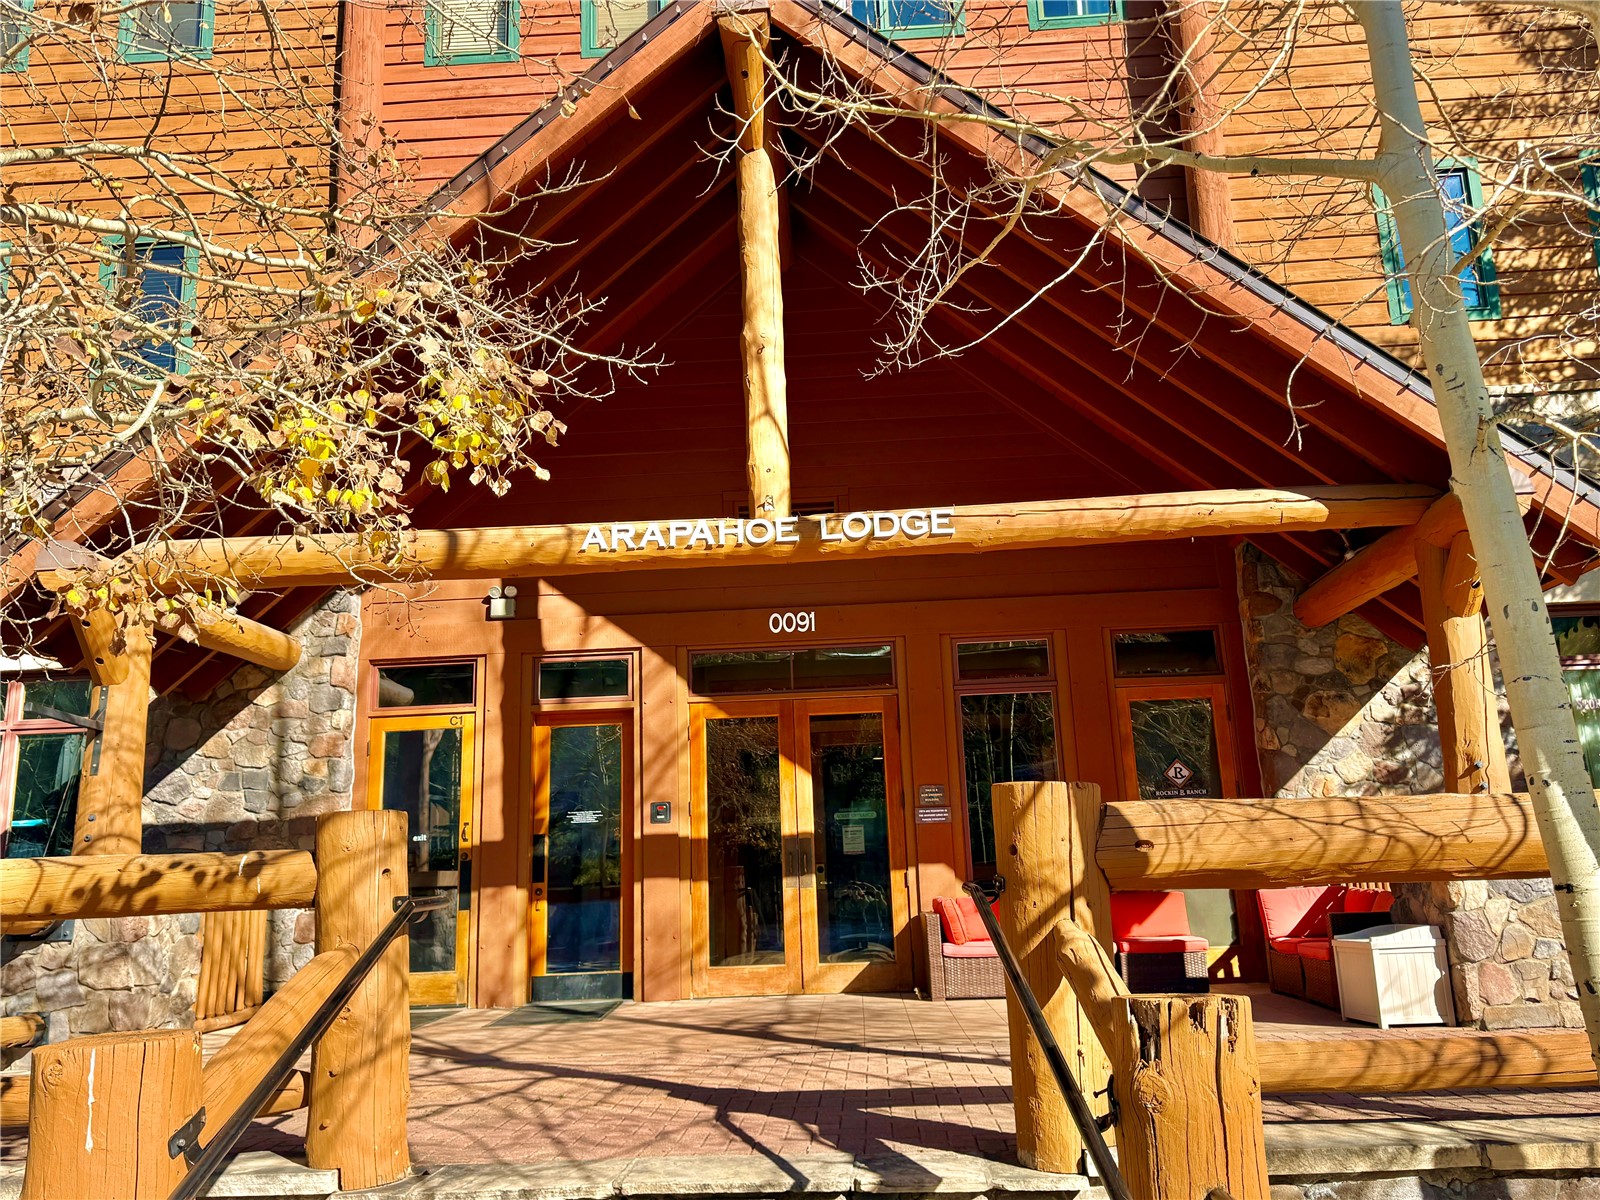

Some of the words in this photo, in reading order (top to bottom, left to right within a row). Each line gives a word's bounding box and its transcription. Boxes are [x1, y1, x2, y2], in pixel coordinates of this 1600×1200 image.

[580, 516, 800, 550] ARAPAHOE
[820, 509, 956, 541] LODGE
[769, 611, 816, 634] 0091
[449, 715, 463, 726] C1
[412, 833, 427, 842] exit
